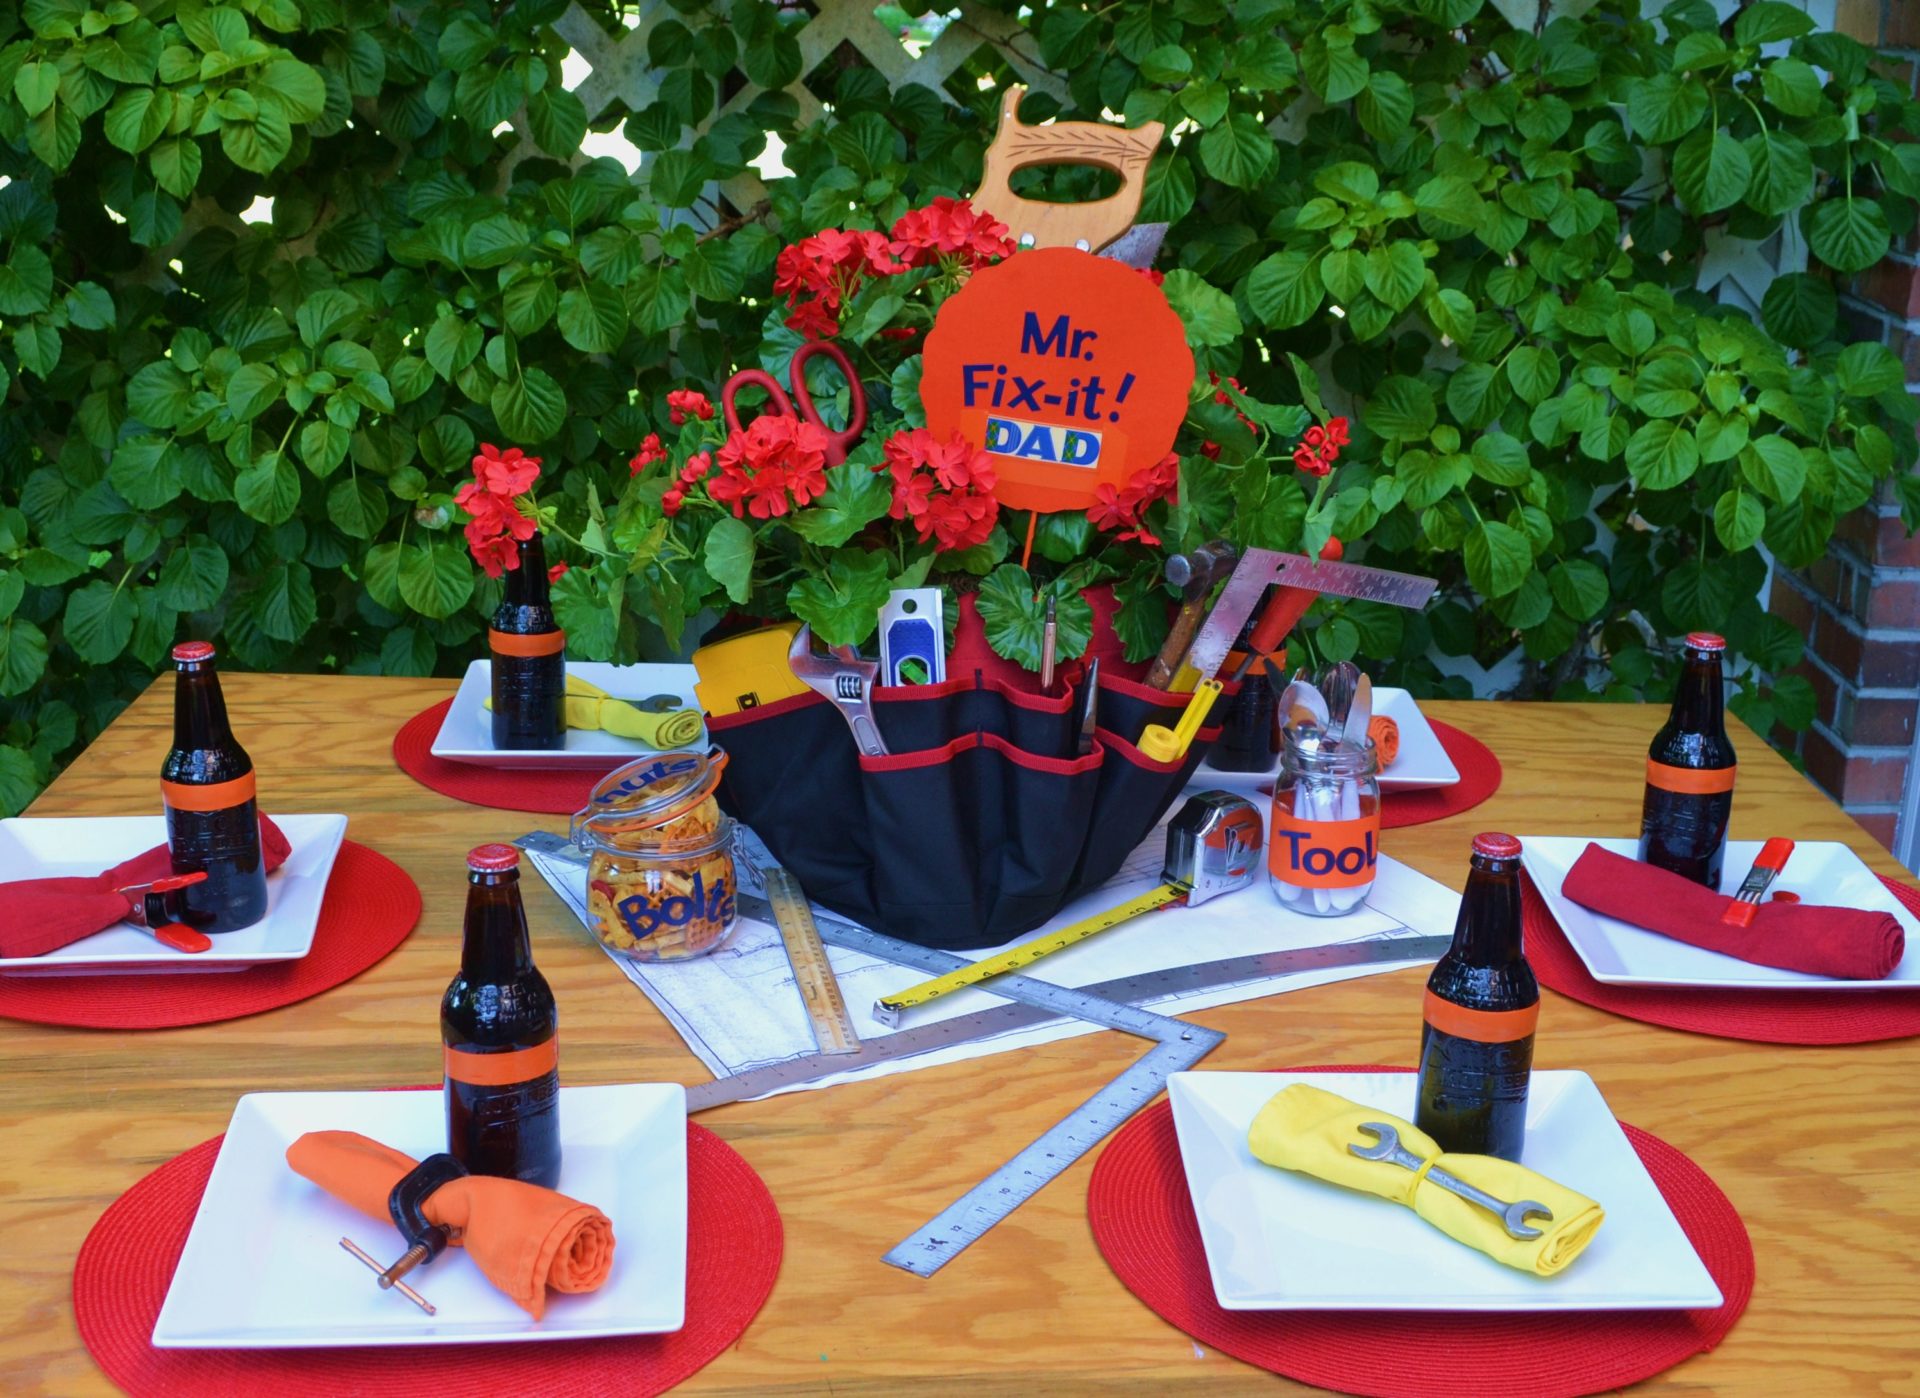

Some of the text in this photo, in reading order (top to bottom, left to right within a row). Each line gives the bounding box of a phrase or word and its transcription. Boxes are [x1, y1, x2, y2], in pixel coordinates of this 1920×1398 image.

[1020, 311, 1098, 361] Mr.
[962, 364, 1136, 423] Fix-it!
[985, 417, 1100, 467] DAD
[594, 758, 698, 803] nuts
[1279, 830, 1376, 875] Tool
[617, 869, 735, 940] Bolts
